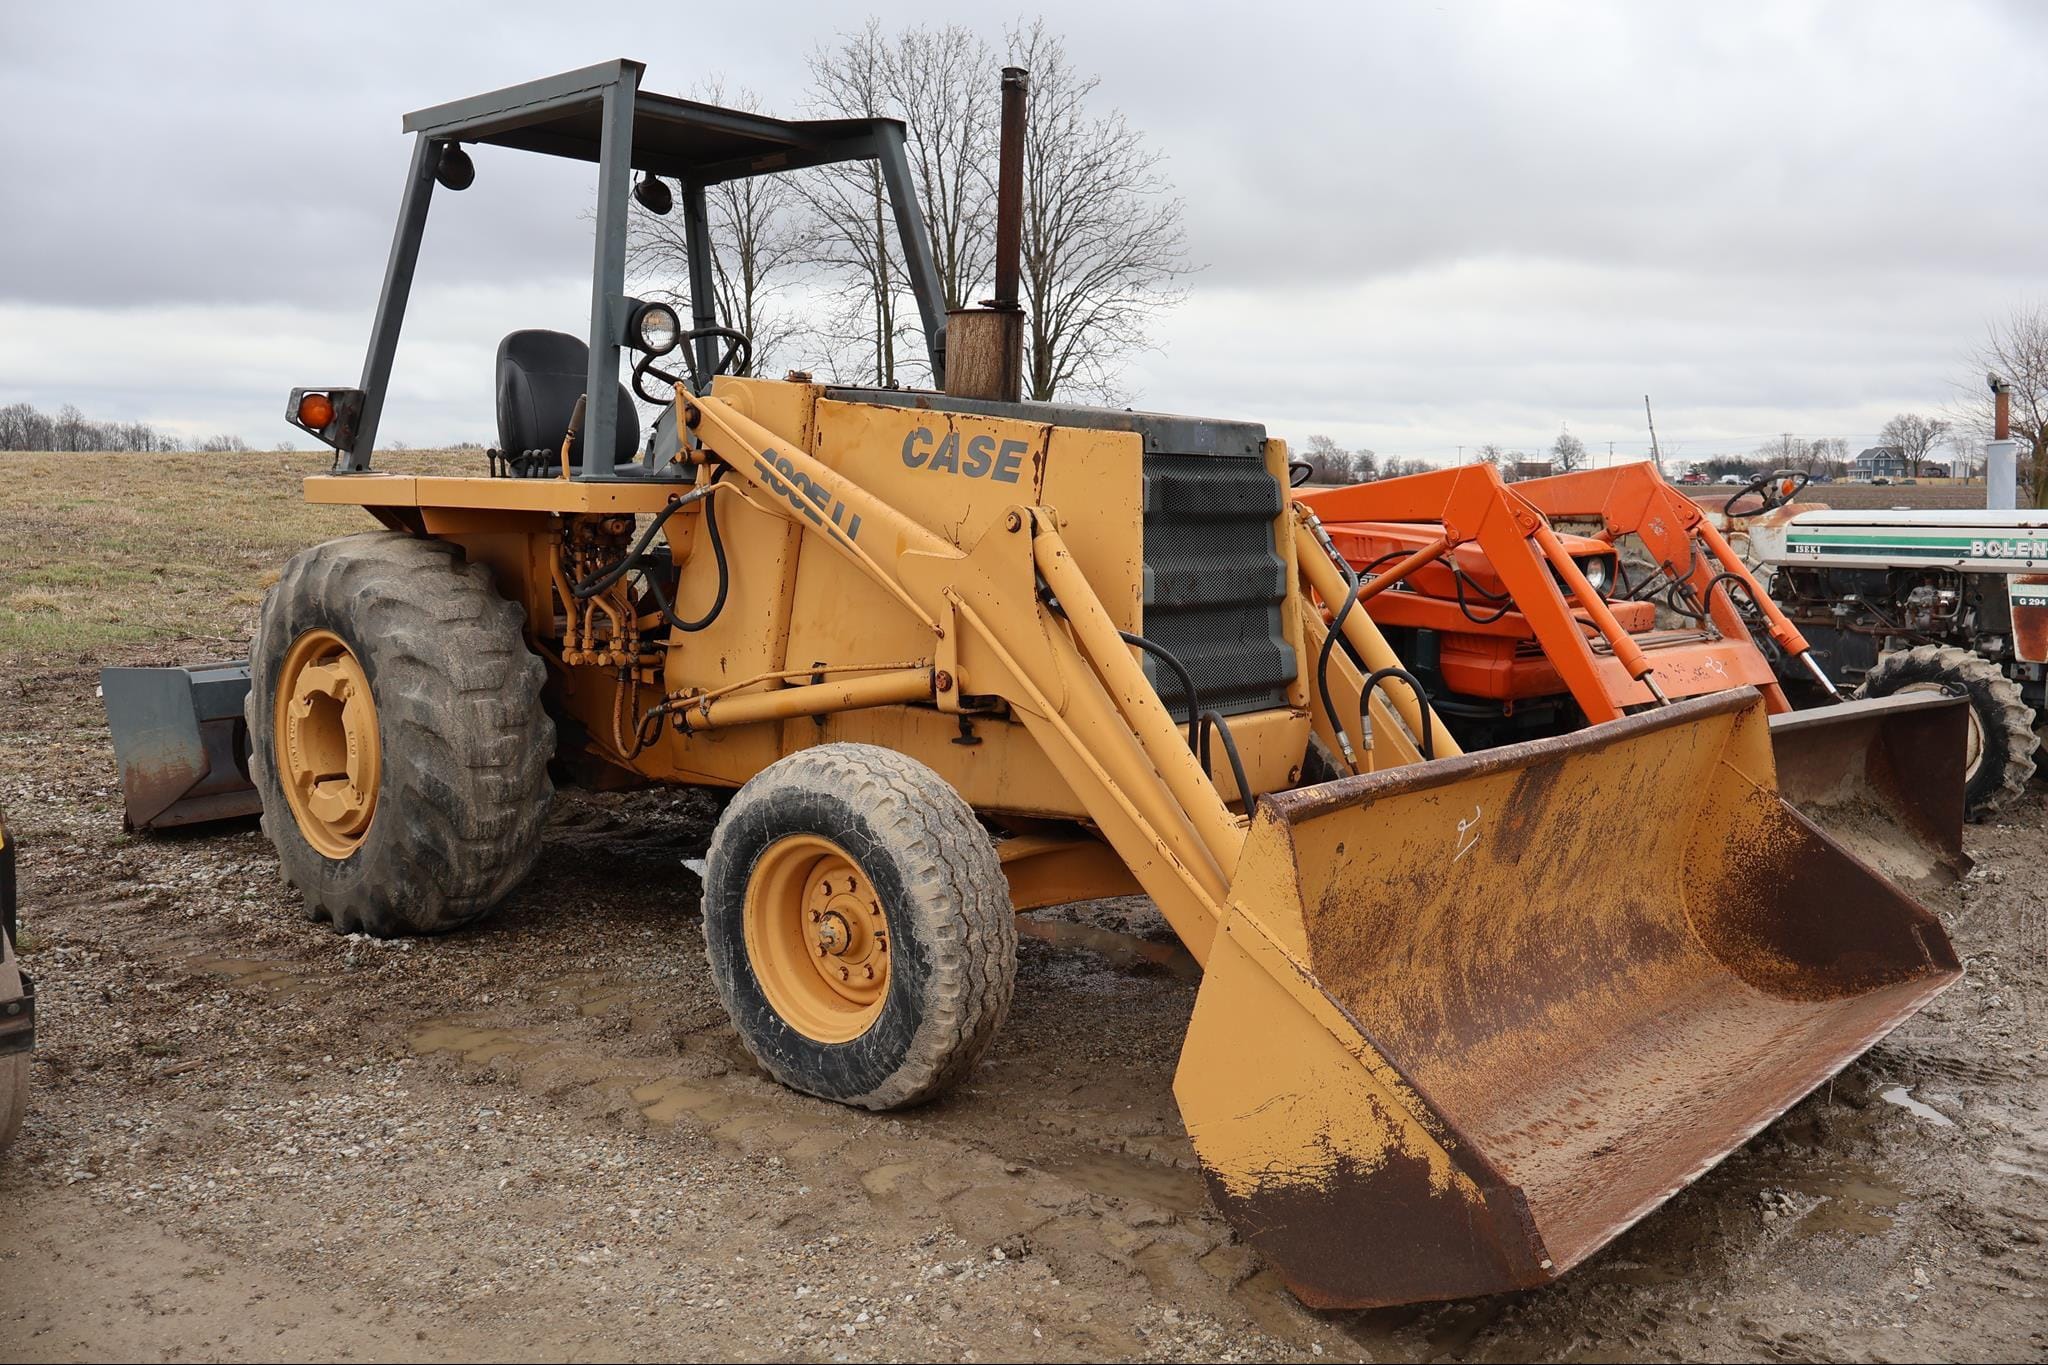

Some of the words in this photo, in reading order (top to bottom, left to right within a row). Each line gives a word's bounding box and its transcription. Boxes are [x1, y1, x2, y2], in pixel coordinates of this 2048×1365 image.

[901, 426, 1030, 484] CASE
[1795, 545, 1821, 554] ISEKI
[2019, 597, 2027, 606] G
[2028, 598, 2047, 607] 294
